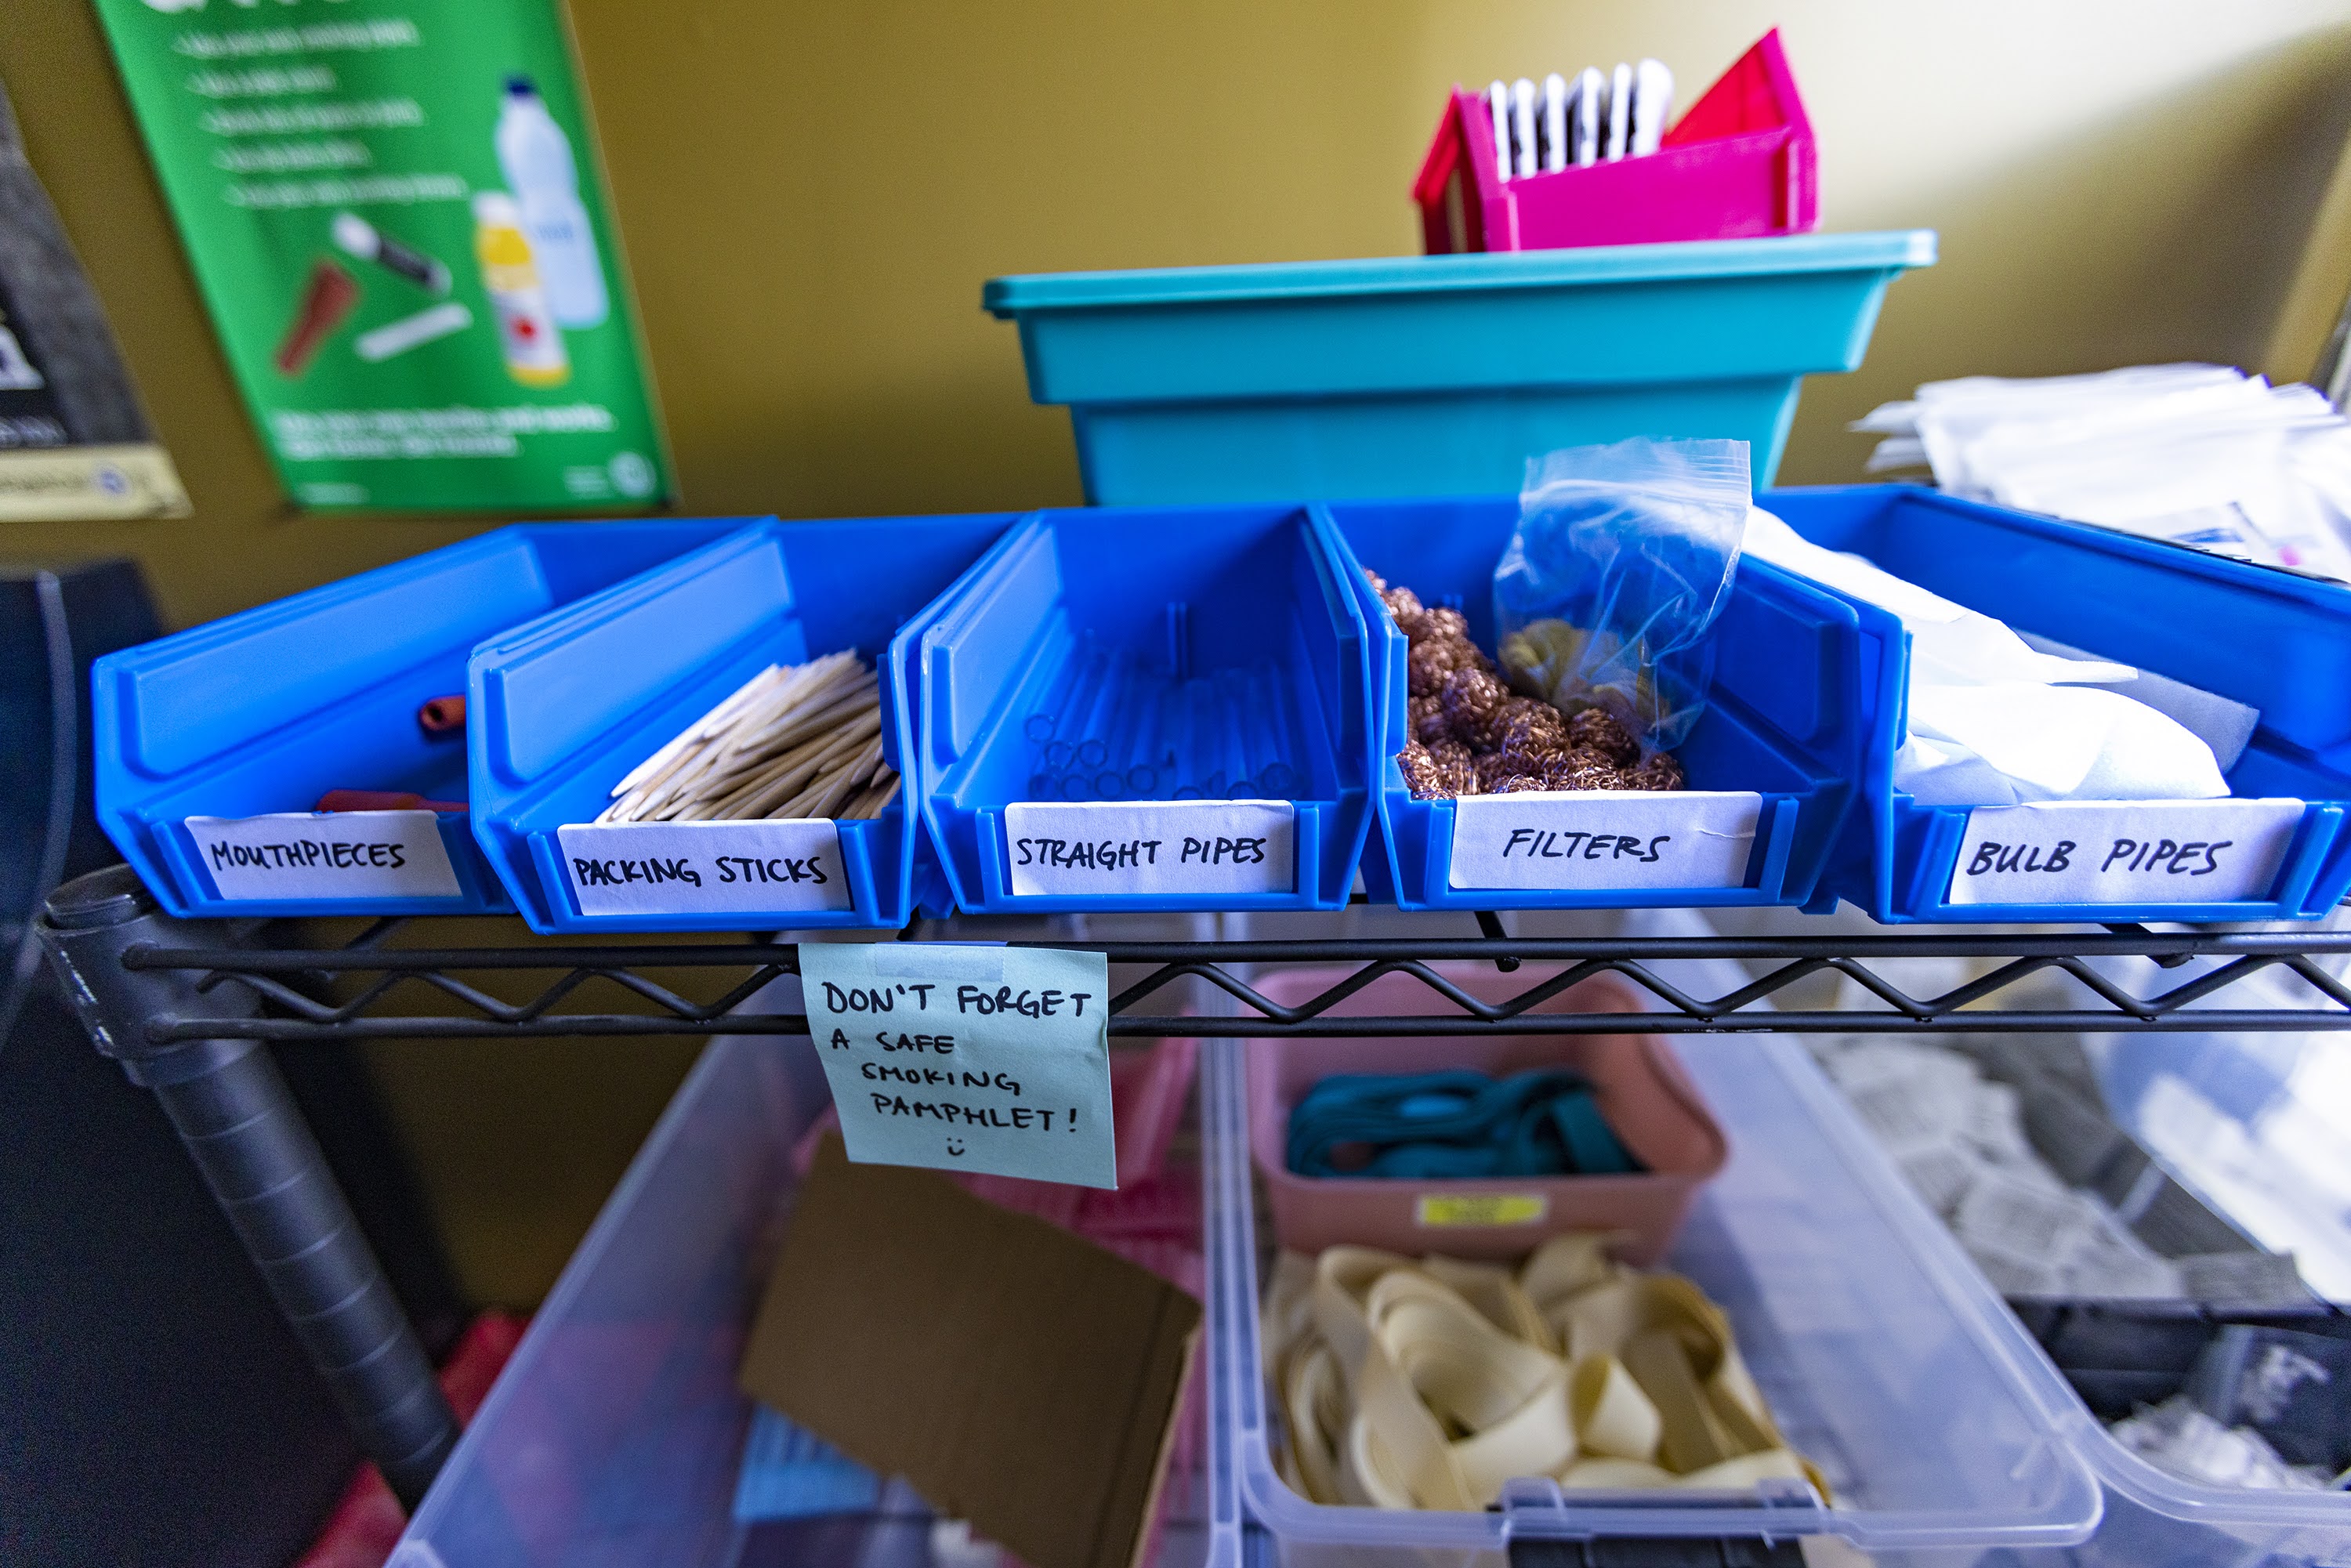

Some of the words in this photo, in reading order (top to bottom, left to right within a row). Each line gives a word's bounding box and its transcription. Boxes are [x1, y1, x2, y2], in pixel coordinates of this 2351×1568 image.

[211, 840, 406, 870] MOUTHPIECES
[1016, 838, 1162, 871] STRAIGHT
[1181, 836, 1267, 864] PIPES
[1502, 828, 1671, 863] FILTERS
[1965, 840, 2077, 876] BULB
[2100, 838, 2233, 876] PIPES
[573, 858, 702, 887] PACKING
[719, 856, 828, 884] STICKS
[821, 981, 936, 1013] DON'T
[957, 985, 1092, 1019] FORGET
[831, 1027, 850, 1050] A
[875, 1031, 955, 1054] SAFE
[861, 1063, 1020, 1095] SMOKING
[870, 1092, 1077, 1132] PAMPHLET!
